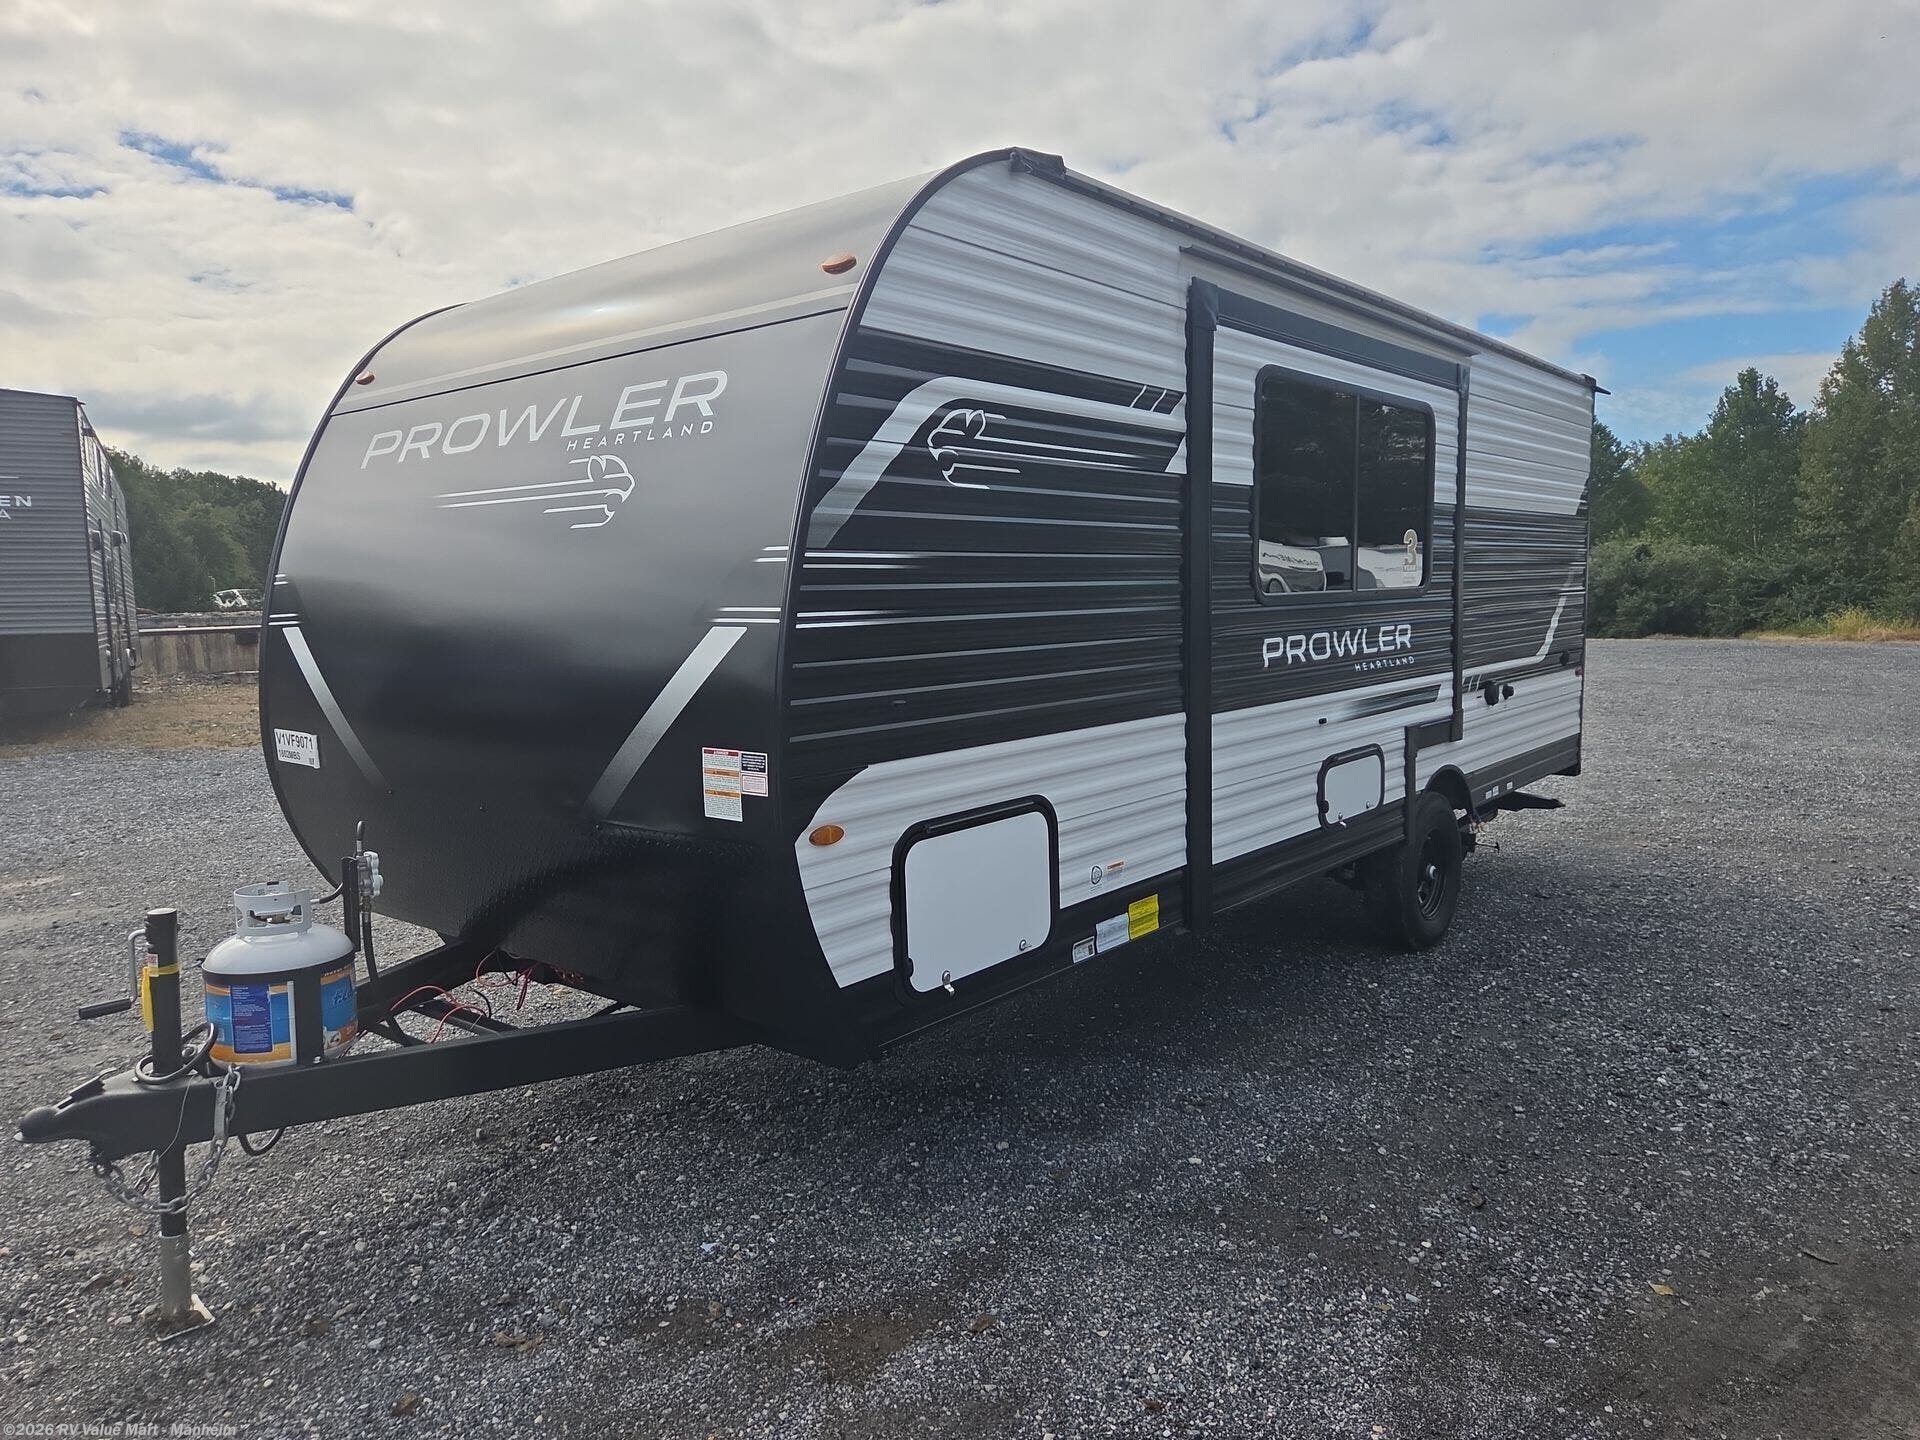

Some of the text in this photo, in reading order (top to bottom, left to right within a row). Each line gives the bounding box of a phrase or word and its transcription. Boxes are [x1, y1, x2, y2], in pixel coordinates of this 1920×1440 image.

[360, 370, 728, 469] PROWLER
[566, 421, 714, 451] HEARTLAND
[1262, 624, 1412, 668] PROWLER
[1355, 656, 1415, 672] HEARTLAND
[275, 731, 313, 750] V1VF9071
